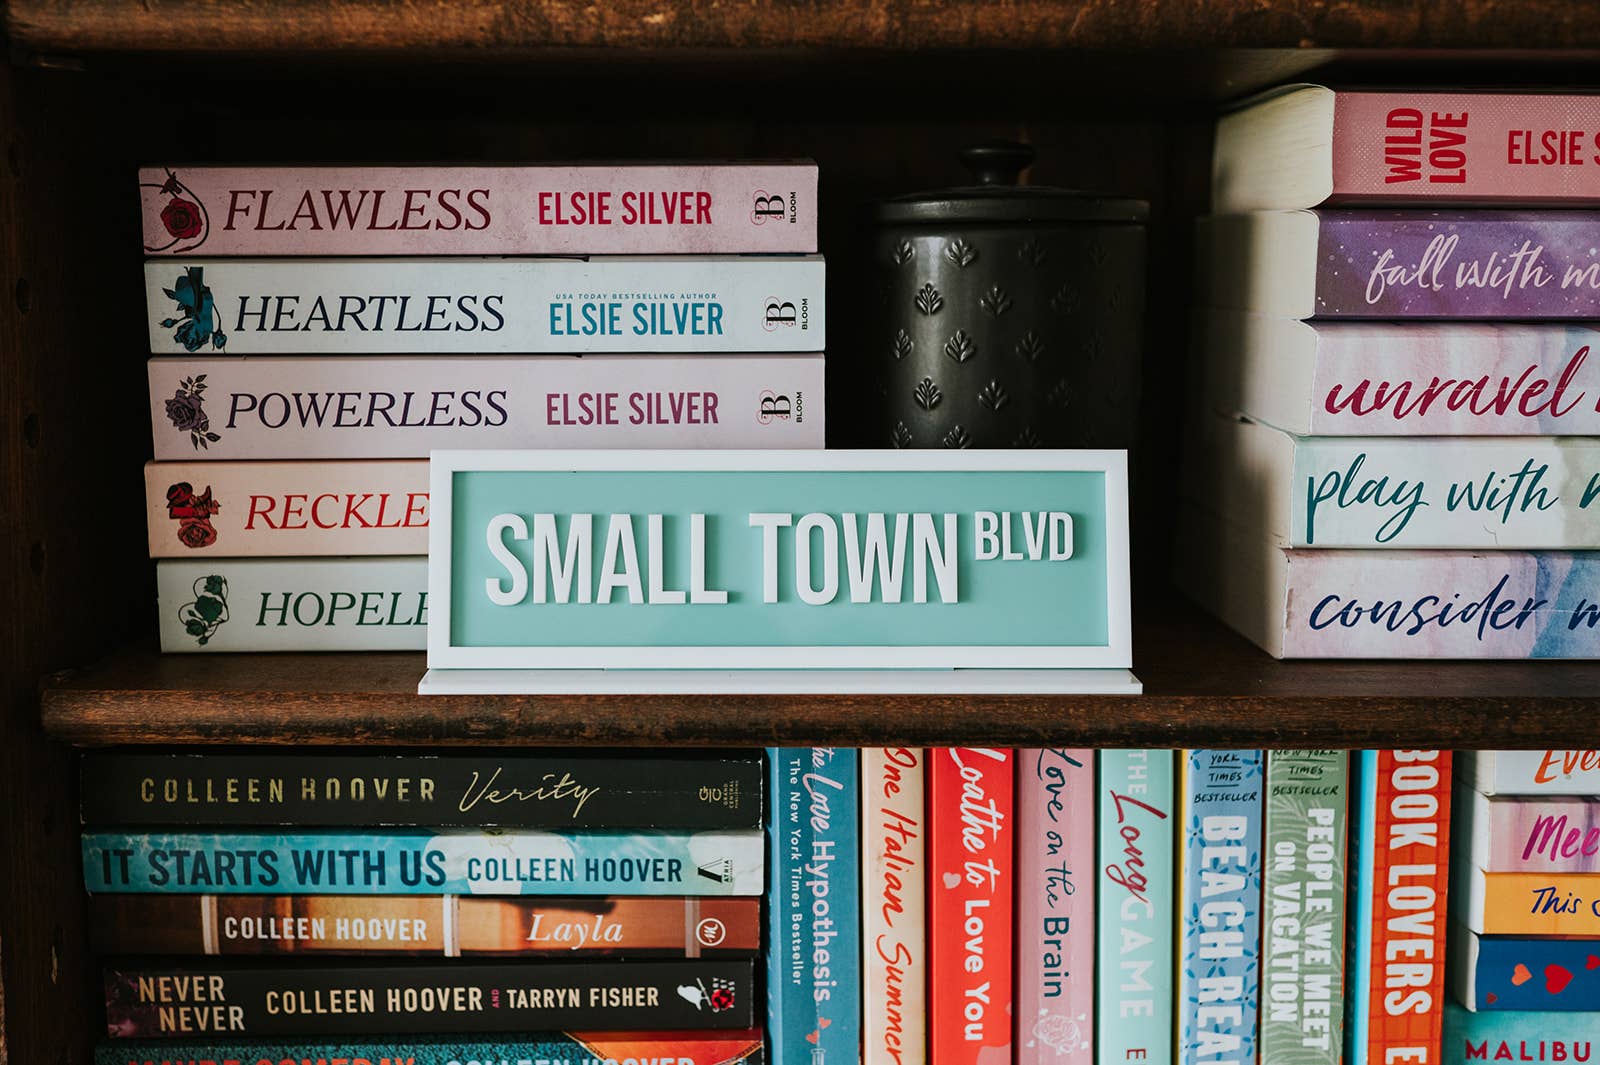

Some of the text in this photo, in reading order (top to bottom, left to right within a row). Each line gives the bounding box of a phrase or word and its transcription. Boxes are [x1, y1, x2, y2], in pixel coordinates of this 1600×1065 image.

[1384, 108, 1423, 184] WILD
[1429, 112, 1468, 184] LOVE
[1507, 130, 1585, 165] ELSIE
[222, 189, 492, 231] FLAWLESS
[538, 191, 712, 225] ELSIE SILVER
[789, 191, 797, 224] BLOOM
[1365, 234, 1459, 304] fall
[1455, 240, 1553, 299] with
[234, 295, 505, 332] HEARTLESS
[612, 292, 676, 300] BESTSELLING
[679, 292, 718, 300] AUTHOR
[801, 298, 809, 330] BLOOM
[549, 302, 724, 336] ELSIE SILVER
[1325, 346, 1590, 420] unravel
[225, 390, 508, 429] POWERLESS
[546, 392, 719, 426] ELSIE SILVER
[795, 391, 803, 423] BLOOM
[244, 492, 430, 531] RECKLE
[1306, 453, 1429, 544] play
[1447, 458, 1559, 524] with
[485, 510, 1074, 605] SMALL TOWN BLVD
[1309, 574, 1548, 641] consider
[1208, 772, 1243, 782] TIMES
[1210, 753, 1241, 765] YORK
[1288, 765, 1324, 775] TIMES
[1534, 750, 1600, 784] Eve
[140, 778, 435, 803] COLLEEN HOOVER
[458, 767, 600, 818] Verity
[802, 773, 844, 834] Love
[1193, 791, 1258, 803] BESTSELLER
[1271, 784, 1340, 797] BESTSELLER
[101, 850, 447, 887] IT STARTS WITH US
[467, 858, 682, 882] COLLEEN HOOVER
[789, 758, 804, 985] The New York Times Bestseller
[1037, 747, 1083, 998] Love on the Brain
[1106, 749, 1168, 1018] THE Long GAME
[876, 747, 918, 1065] One Italian Summer
[950, 747, 1007, 1041] Loathe to Love You
[1531, 886, 1583, 916] This
[224, 917, 427, 941] COLLEEN HOOVER
[526, 914, 624, 950] Layla
[805, 841, 838, 1002] Hypothesis
[1195, 815, 1248, 1065] BEACH REA
[1270, 841, 1301, 1023] ON VACATION
[1302, 808, 1335, 1051] PEOPLE WE MEET
[1384, 863, 1438, 1016] LOVERS
[137, 975, 226, 1003] NEVER
[266, 986, 659, 1015] COLLEEN HOOVER AND TARRYN FISHER
[158, 1005, 246, 1031] NEVER
[1465, 1039, 1591, 1063] MALIBU
